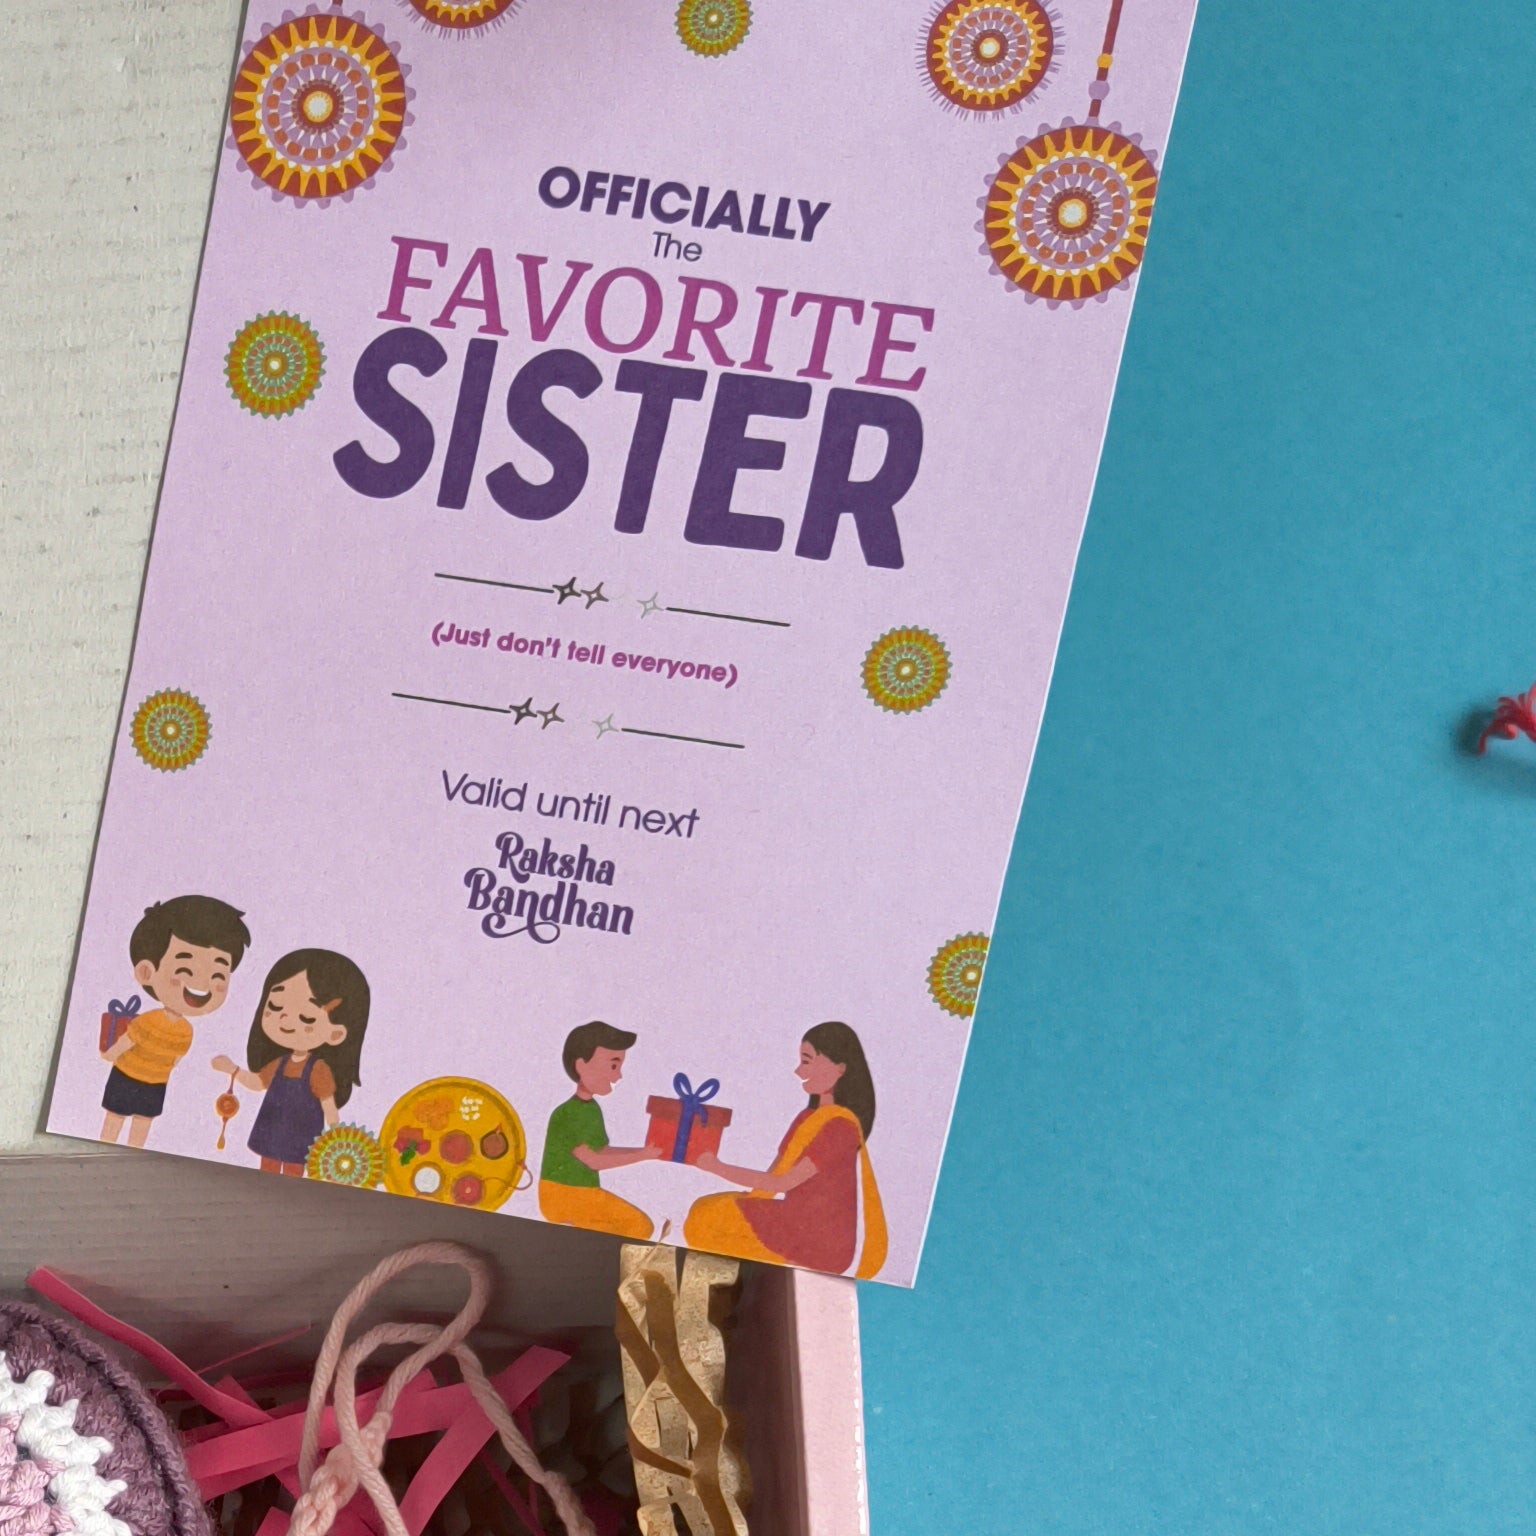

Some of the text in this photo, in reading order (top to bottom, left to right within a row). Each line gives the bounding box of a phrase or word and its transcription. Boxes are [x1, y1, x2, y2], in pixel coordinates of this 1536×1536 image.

[538, 166, 831, 242] OFFICIALLY
[653, 231, 702, 262] The
[377, 235, 935, 391] FAVORITE
[333, 327, 924, 569] SISTER
[432, 621, 737, 689] (Just don't tell everyone)
[442, 770, 700, 838] Valid until next
[495, 831, 615, 886] Raksha
[464, 867, 634, 944] Bandhan
